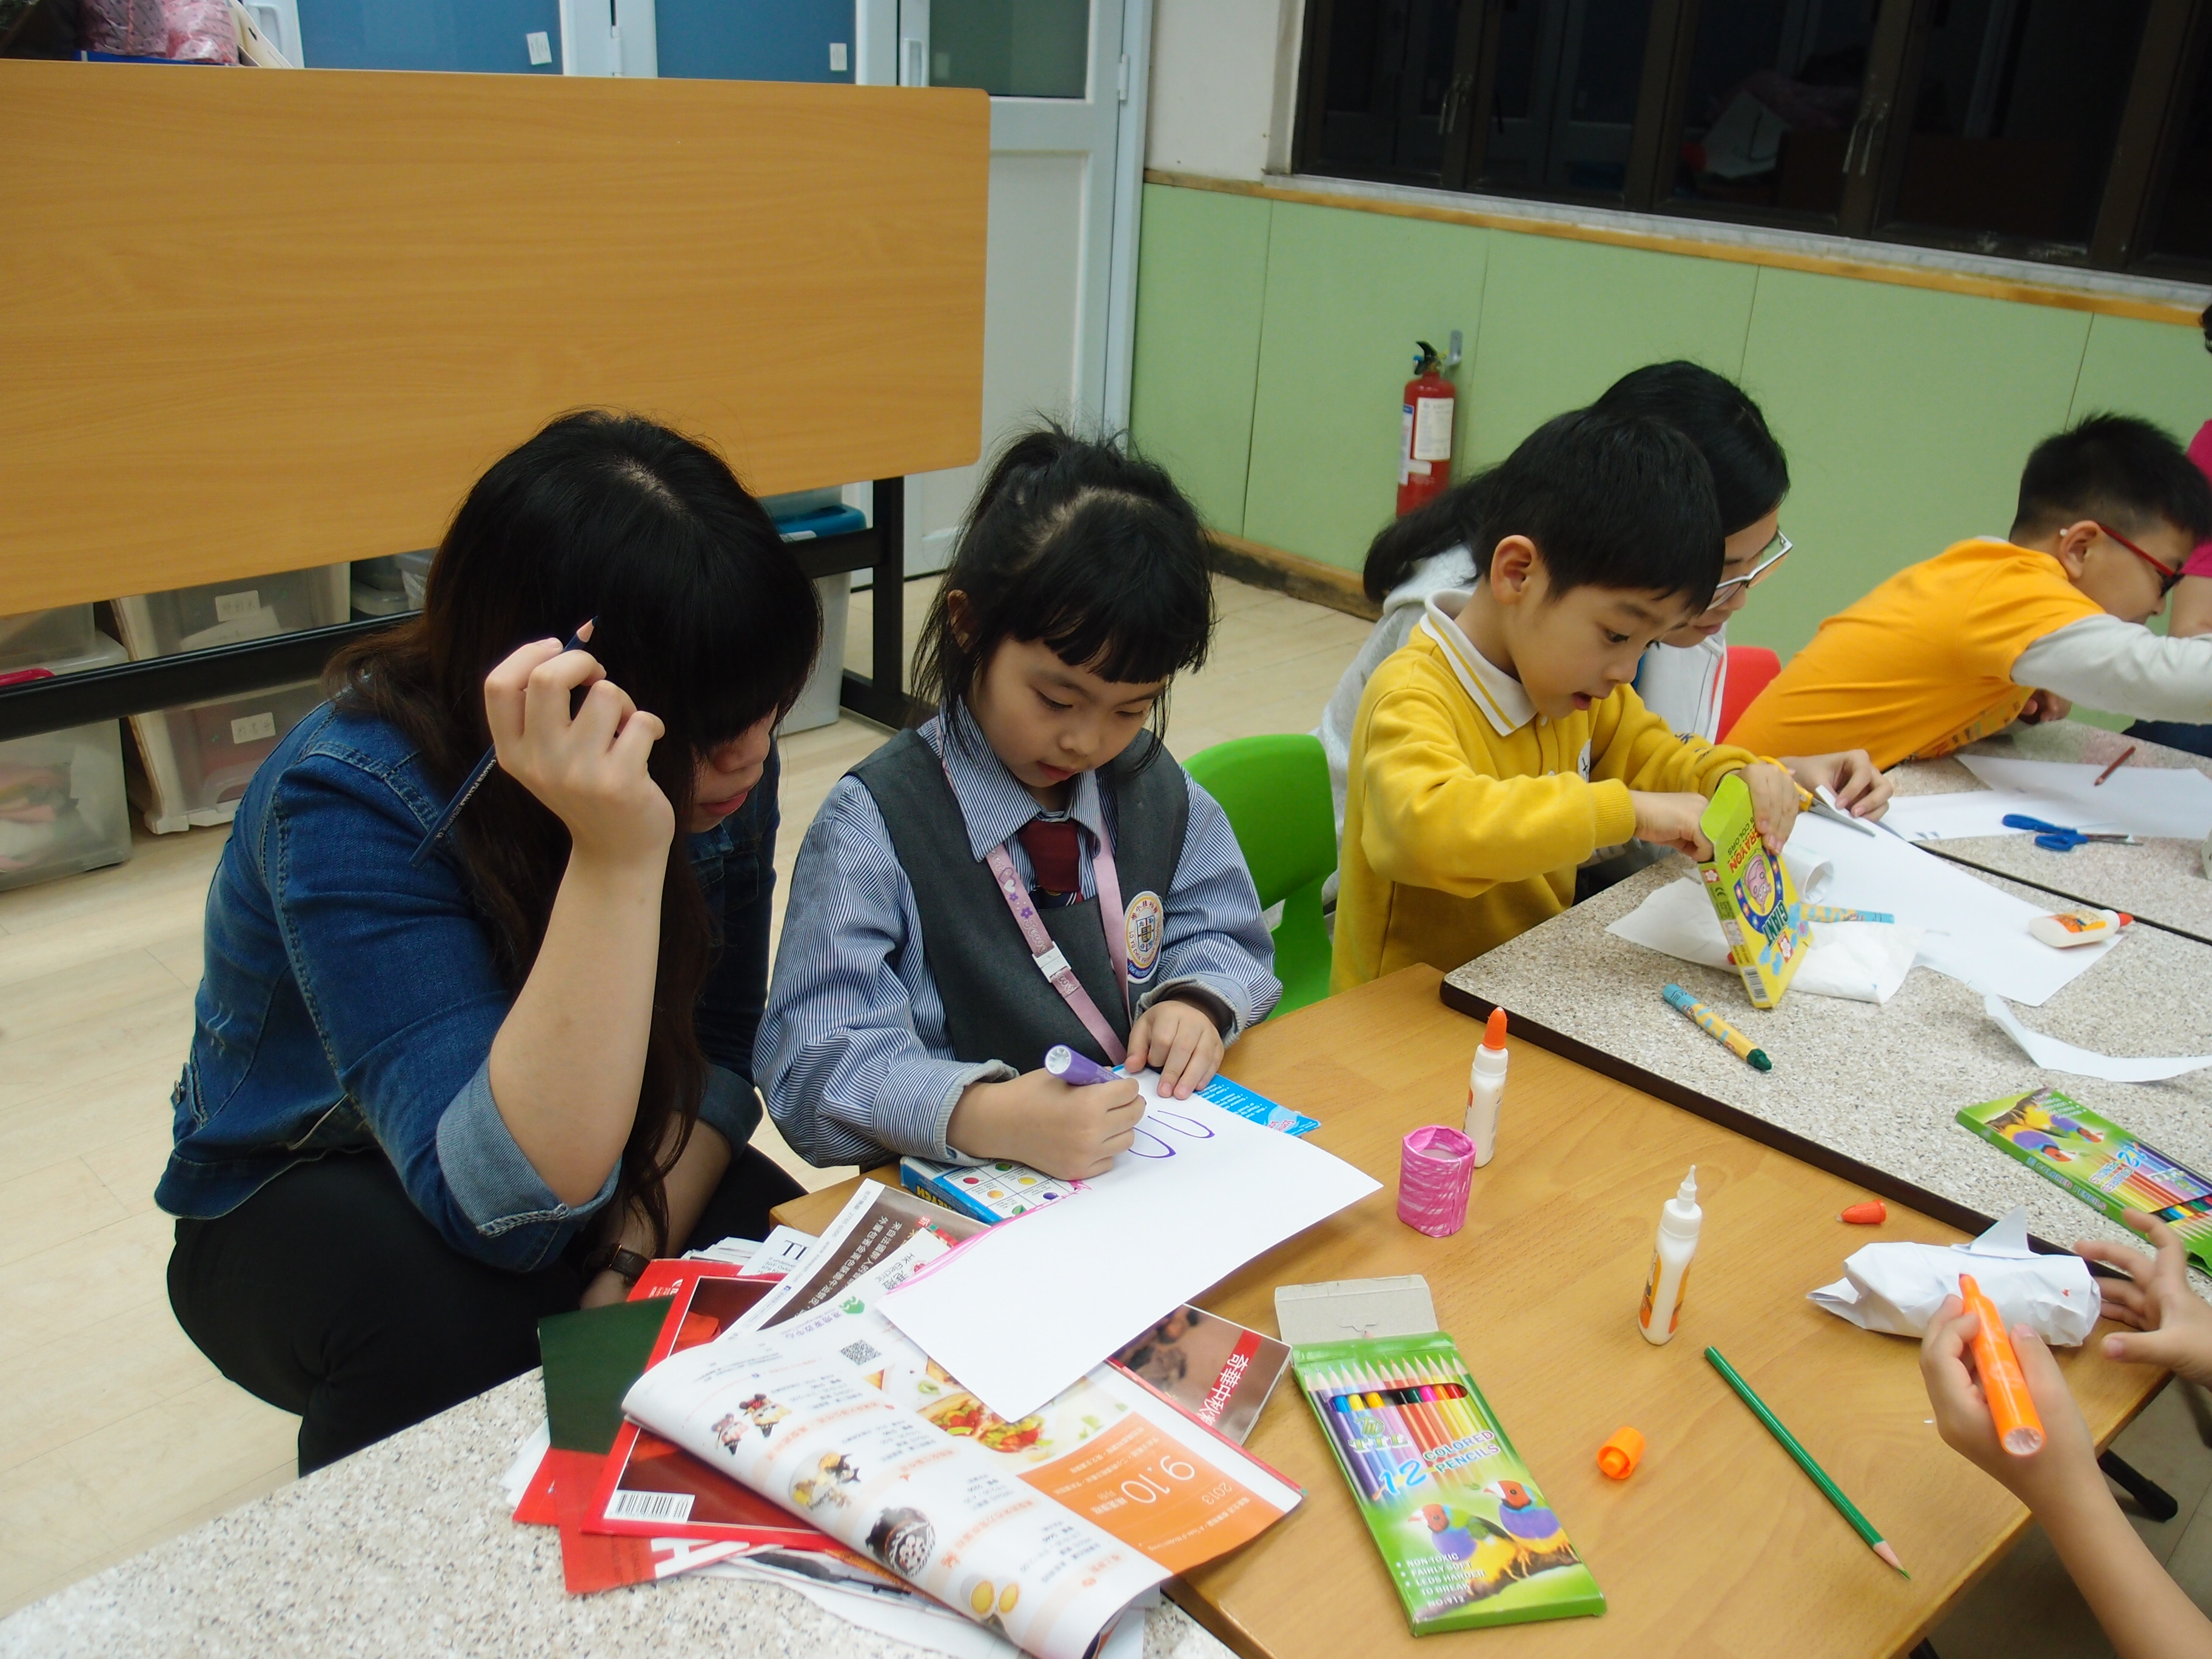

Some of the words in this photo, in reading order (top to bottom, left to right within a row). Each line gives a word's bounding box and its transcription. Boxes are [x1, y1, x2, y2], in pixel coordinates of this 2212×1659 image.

[1728, 823, 1750, 856] COLORS
[1762, 900, 1788, 950] GIANT
[2073, 1182, 2107, 1210] PENCILS
[902, 1252, 915, 1264] HK
[1379, 1459, 1427, 1495] 12
[1423, 1430, 1495, 1461] COLORED
[1434, 1444, 1500, 1473] PENCILS
[1202, 1481, 1233, 1505] 2013
[1411, 1566, 1446, 1577] FAIRLY
[1446, 1561, 1472, 1571] SOFT
[1443, 1569, 1486, 1583] HARDER
[1422, 1587, 1434, 1596] TO
[1435, 1582, 1471, 1594] BREAK
